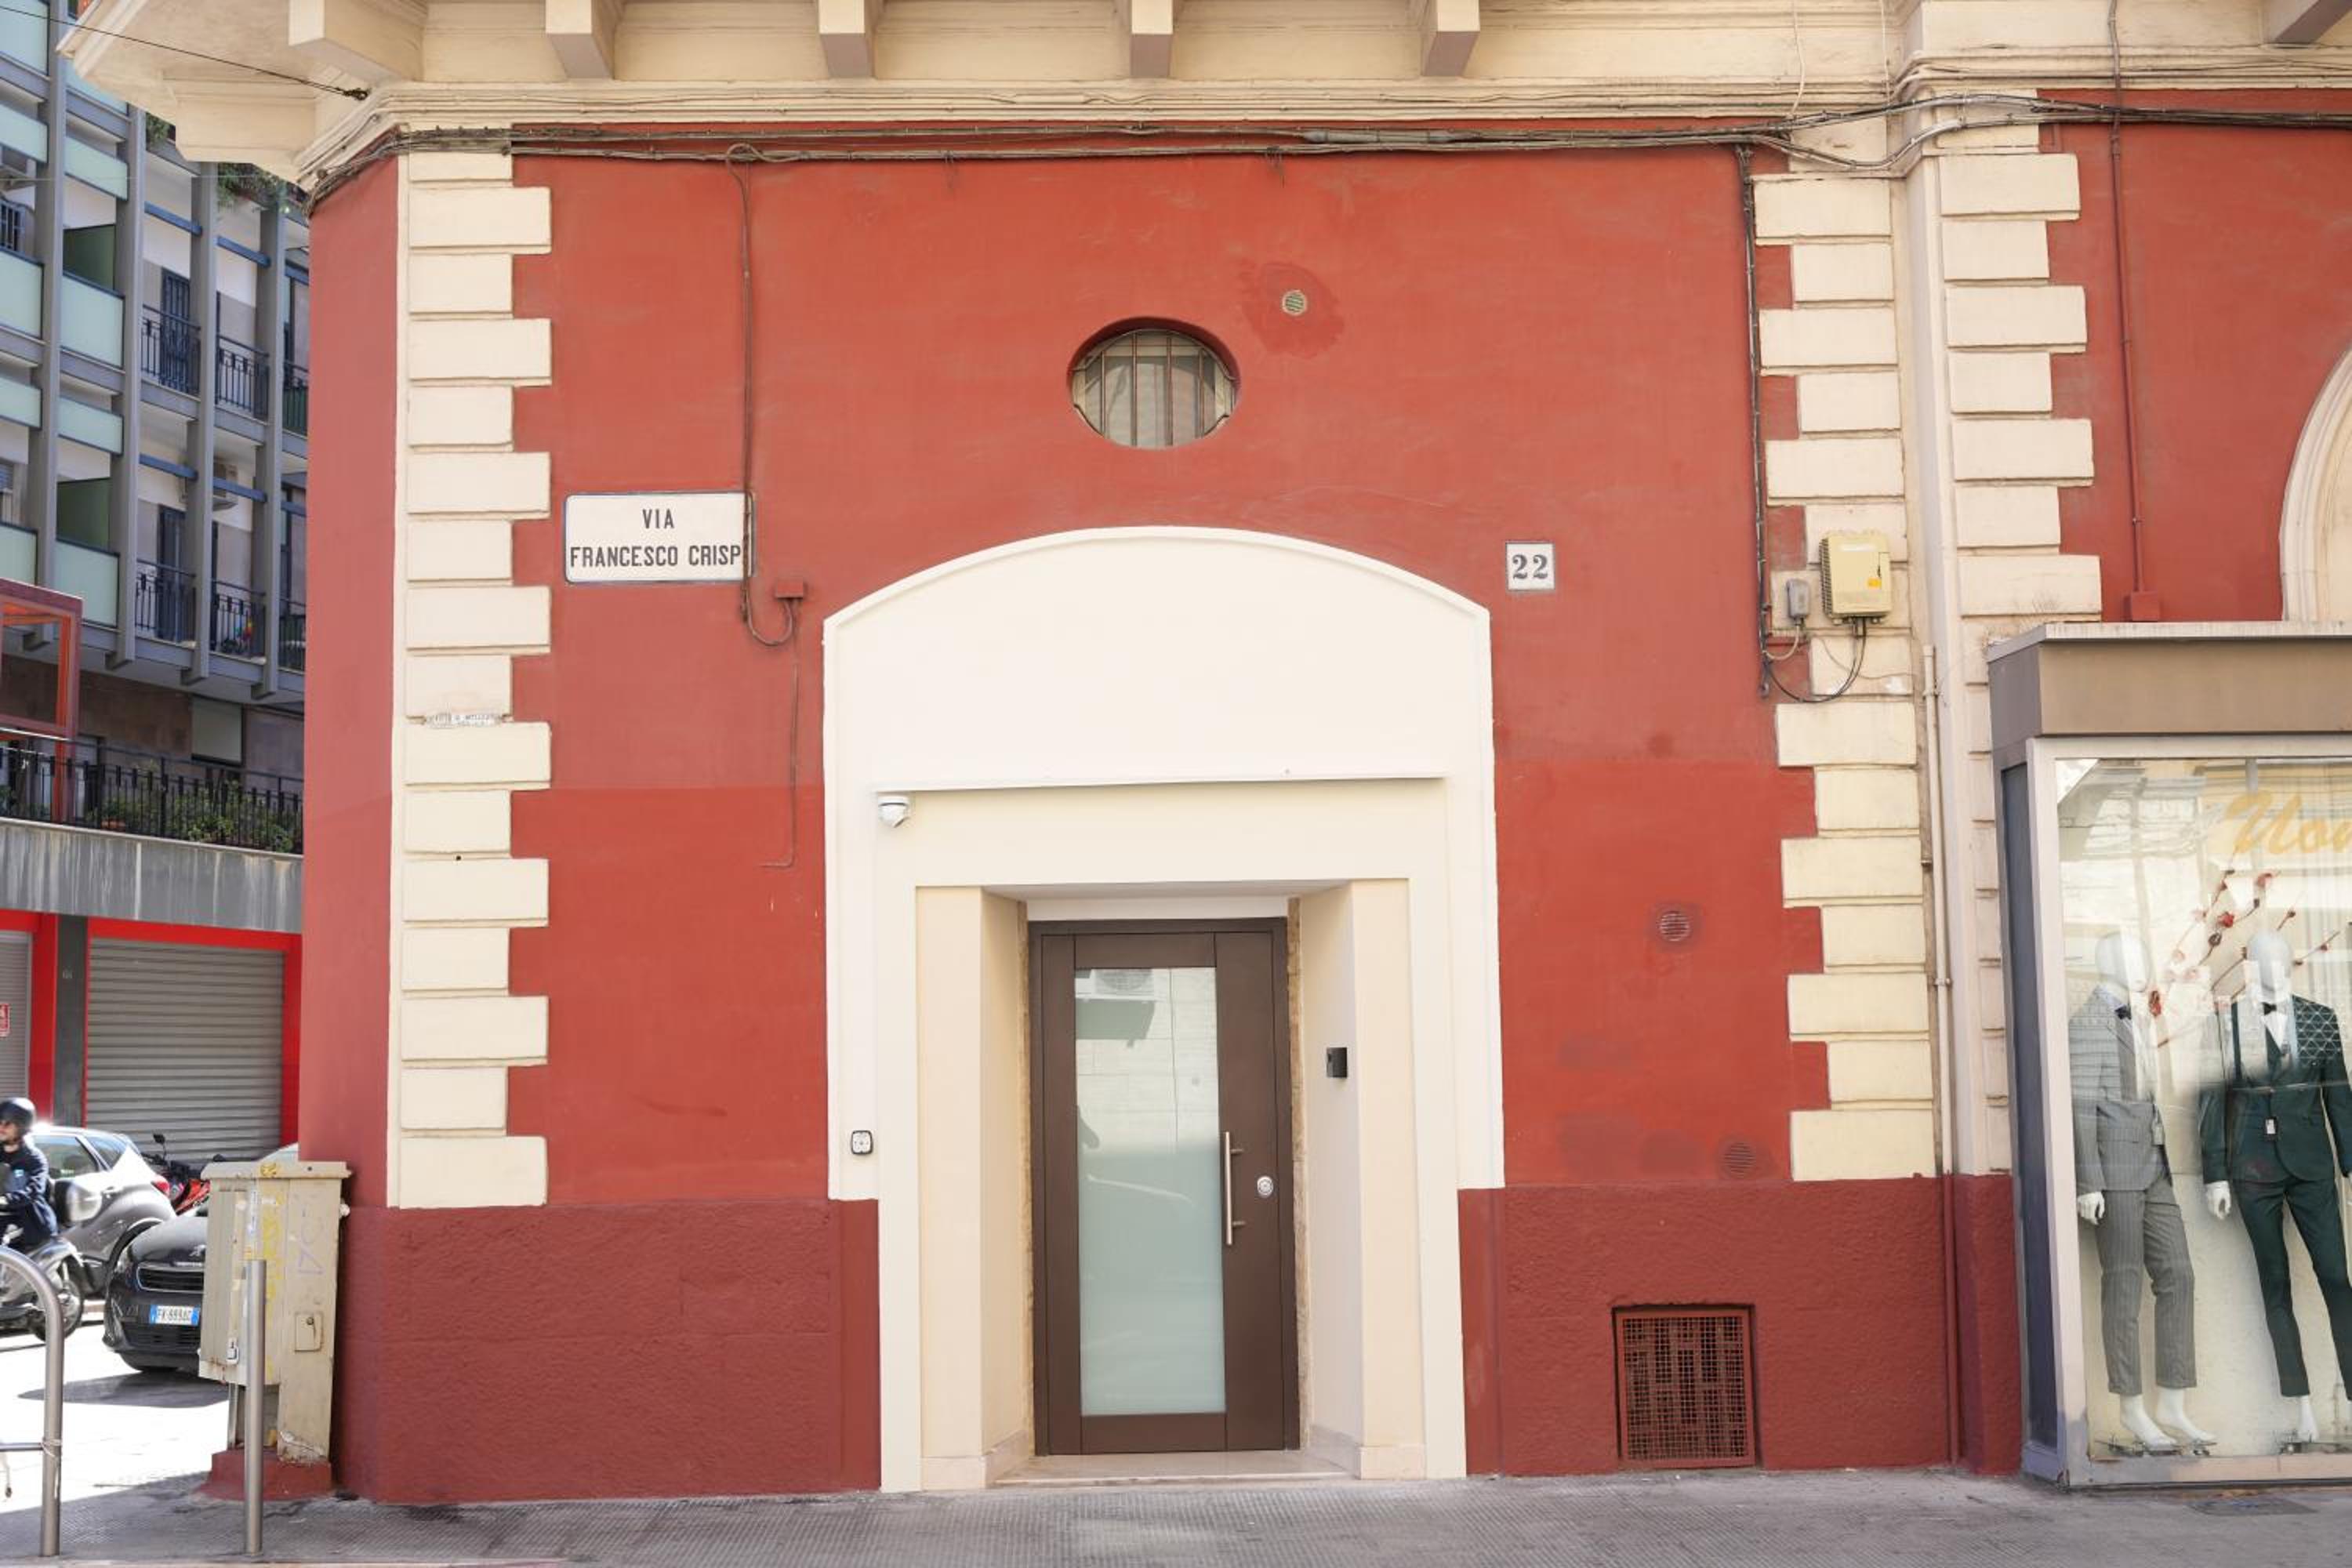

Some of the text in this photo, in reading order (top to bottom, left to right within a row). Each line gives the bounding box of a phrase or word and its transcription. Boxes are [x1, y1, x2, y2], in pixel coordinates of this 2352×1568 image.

[642, 509, 675, 529] VIA
[570, 544, 742, 567] FRANCESCO CRISP
[1512, 554, 1548, 579] 22
